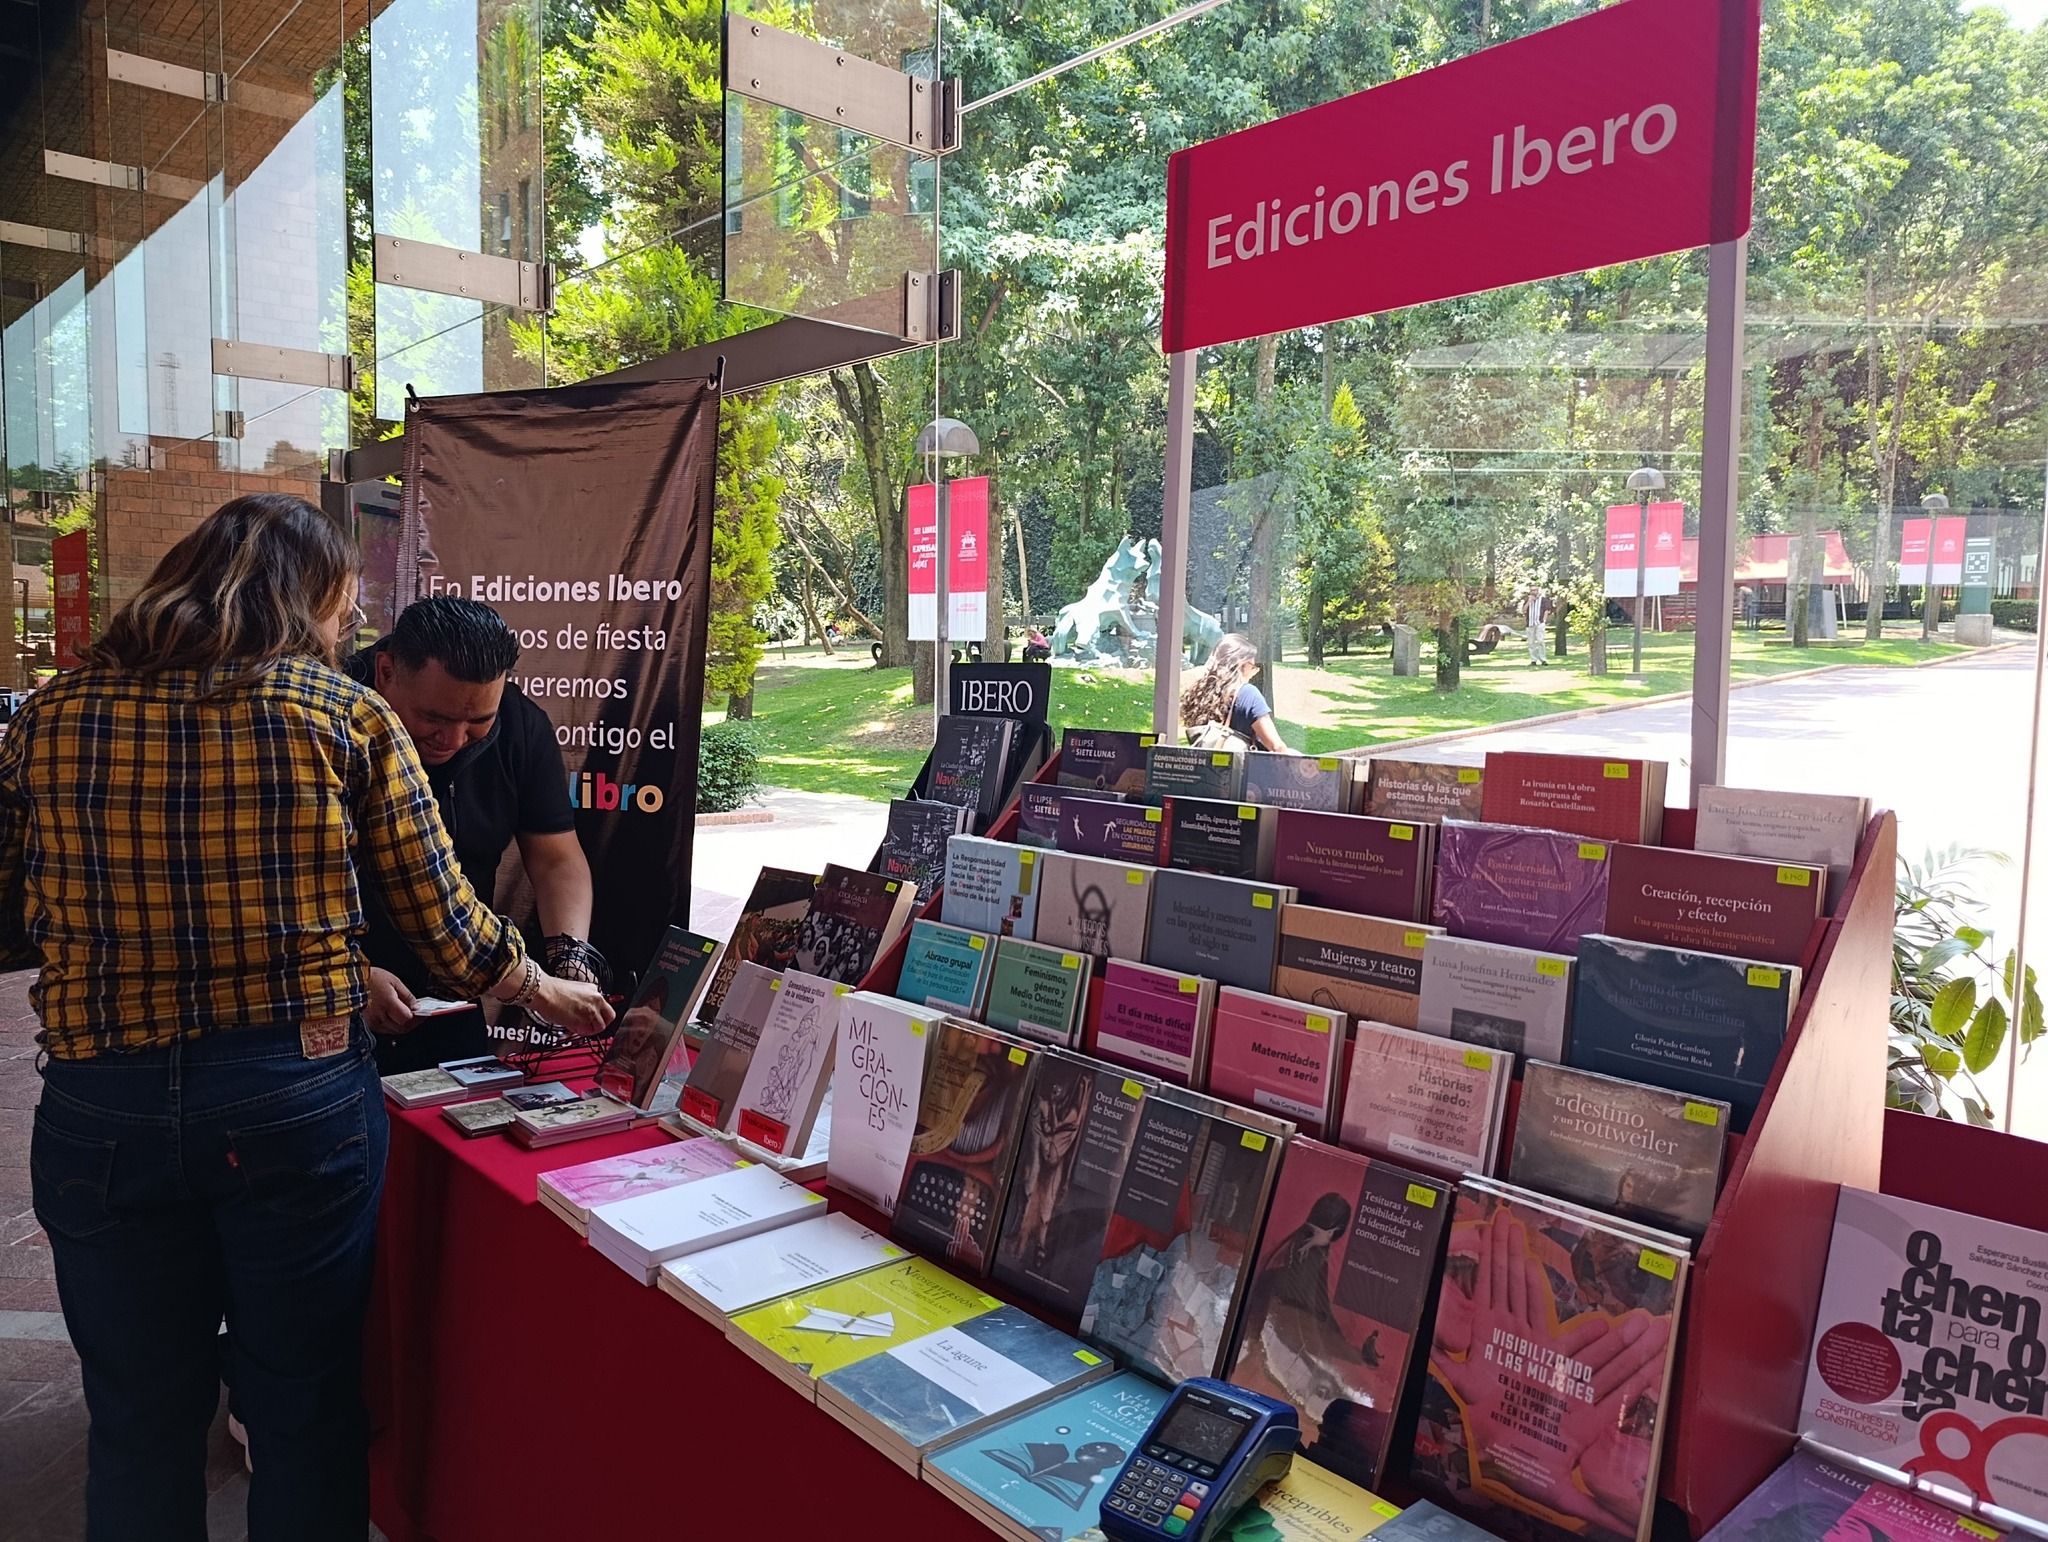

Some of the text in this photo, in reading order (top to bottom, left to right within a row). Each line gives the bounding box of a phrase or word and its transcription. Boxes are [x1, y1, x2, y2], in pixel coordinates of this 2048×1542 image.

[1207, 104, 1678, 269] Ediciones Ibero
[471, 575, 601, 602] Ediciones
[608, 574, 682, 601] Ibero
[556, 623, 667, 650] de fiesta
[507, 676, 628, 699] ueremos
[960, 680, 1033, 714] IBERO
[556, 721, 675, 755] ontigo el
[569, 771, 664, 813] libro
[1267, 787, 1311, 801] MIRADAS
[1378, 777, 1471, 798] Historias de las que
[1522, 779, 1531, 787] La
[1532, 780, 1555, 789] ironía
[1577, 784, 1595, 792] obra
[1533, 790, 1582, 801] temprana de
[1386, 790, 1461, 806] estamos hechas
[1520, 798, 1595, 812] Rosario Castellanos
[1121, 833, 1155, 844] CONTEXTOS
[1306, 841, 1384, 863] Nuevos rumbos
[1641, 884, 1772, 913] Creación, recepción
[1677, 907, 1727, 924] y efecto
[1633, 916, 1775, 945] Una aproximación hermenéutica
[1681, 934, 1737, 951] obra literaria
[925, 950, 973, 970] Abrazo grupal
[1321, 947, 1416, 977] Mujeres y teatro
[1432, 956, 1556, 987] Luisa Josefina Hernández
[1024, 966, 1068, 986] Feminismos,
[1010, 986, 1065, 1009] Medio Oriente:
[1034, 982, 1059, 997] género
[1117, 1003, 1191, 1032] El día más difícil
[1694, 1004, 1745, 1028] literatura
[849, 1016, 878, 1043] MI-
[1635, 1033, 1657, 1045] Gloria
[851, 1046, 893, 1074] GRA-
[1251, 1042, 1321, 1070] Maternidades
[1631, 1043, 1662, 1058] Georgina
[1690, 1055, 1713, 1067] Rocha
[1278, 1066, 1291, 1076] en
[1418, 1069, 1473, 1093] Historias
[859, 1074, 909, 1112] CION-
[1096, 1091, 1136, 1112] Otra forma
[1407, 1083, 1470, 1108] sin miedo:
[868, 1104, 886, 1132] ES
[1093, 1103, 1124, 1121] de besar
[1398, 1109, 1421, 1122] contra
[1424, 1116, 1454, 1131] mujeres
[1435, 1108, 1444, 1116] en
[1447, 1108, 1468, 1122] redes
[1555, 1093, 1644, 1129] El destino
[1147, 1119, 1187, 1139] Sublevación
[1433, 1130, 1464, 1147] 25 años
[1561, 1117, 1573, 1126] un
[1575, 1118, 1679, 1156] rottweiler
[1144, 1132, 1189, 1153] reverberancia
[1365, 1191, 1401, 1210] Tesituras
[1358, 1214, 1407, 1238] la identidad
[1413, 1220, 1424, 1231] de
[1355, 1228, 1421, 1257] como disidencia
[1977, 1244, 2020, 1263] Esperanza
[1969, 1252, 2042, 1279] Salvador Sánchez
[936, 1339, 953, 1352] La
[1947, 1320, 2000, 1351] para
[1492, 1328, 1593, 1383] VISIBILIZANDO
[1484, 1344, 1595, 1404] A LAS MUJERES
[1498, 1374, 1520, 1391] EN LO
[1490, 1411, 1511, 1427] RETOS
[1504, 1390, 1561, 1424] EN PAREJA
[1507, 1404, 1529, 1422] EN LA
[1820, 1398, 1900, 1434] ESCRITORES EN
[1815, 1463, 1871, 1492] Salud
[1267, 1485, 1354, 1535] erceptibles
[1867, 1497, 1957, 1538] y sexual
